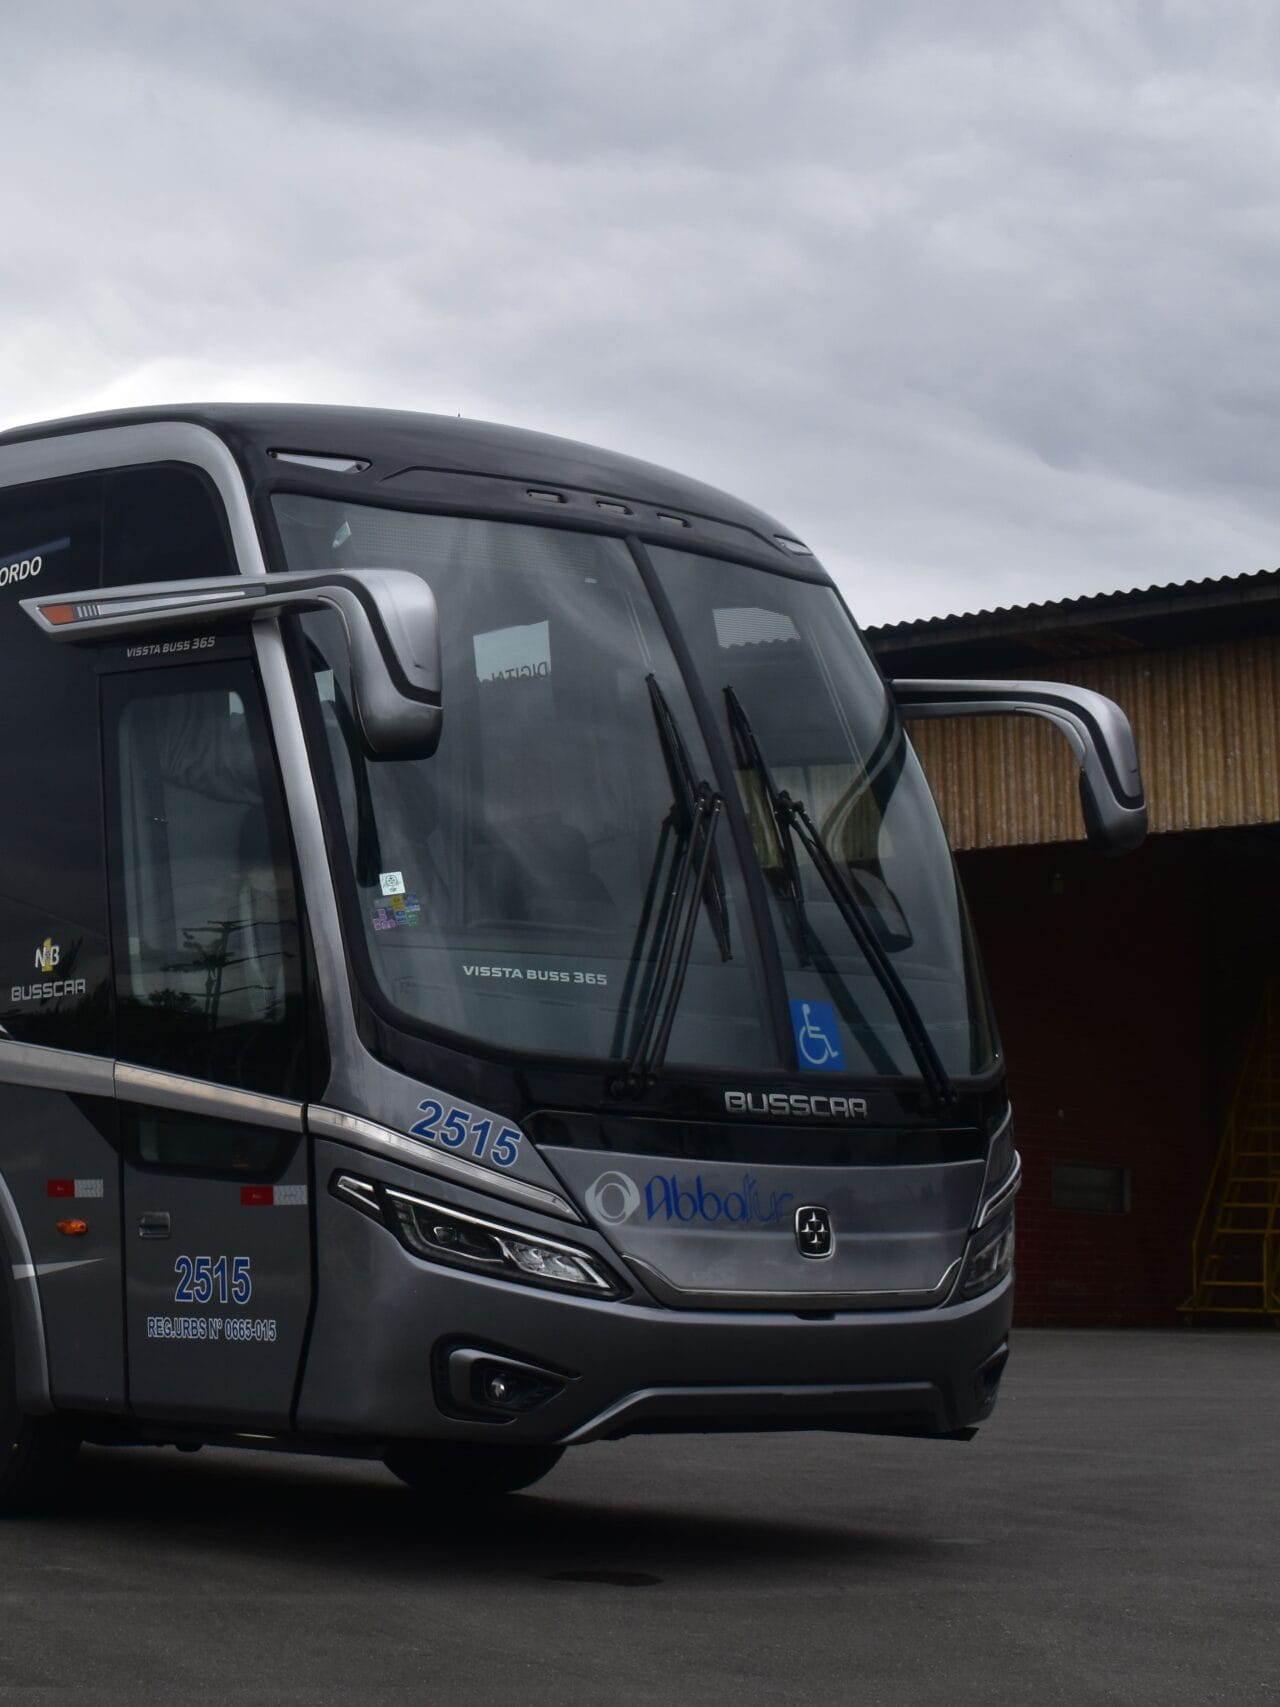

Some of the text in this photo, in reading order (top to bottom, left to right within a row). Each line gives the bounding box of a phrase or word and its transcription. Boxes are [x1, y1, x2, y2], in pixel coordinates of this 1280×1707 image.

[126, 636, 216, 658] VISSTA BUSS 365
[462, 965, 608, 986] VISSTA BUSS 365
[11, 978, 87, 1002] BUSSCAR
[724, 1091, 868, 1119] BUSSCAR
[409, 1099, 521, 1168] 2515
[645, 1173, 795, 1223] Abbatur
[174, 1255, 252, 1305] 2515
[147, 1316, 208, 1340] REG.URBS
[224, 1318, 277, 1342] 0665-015
